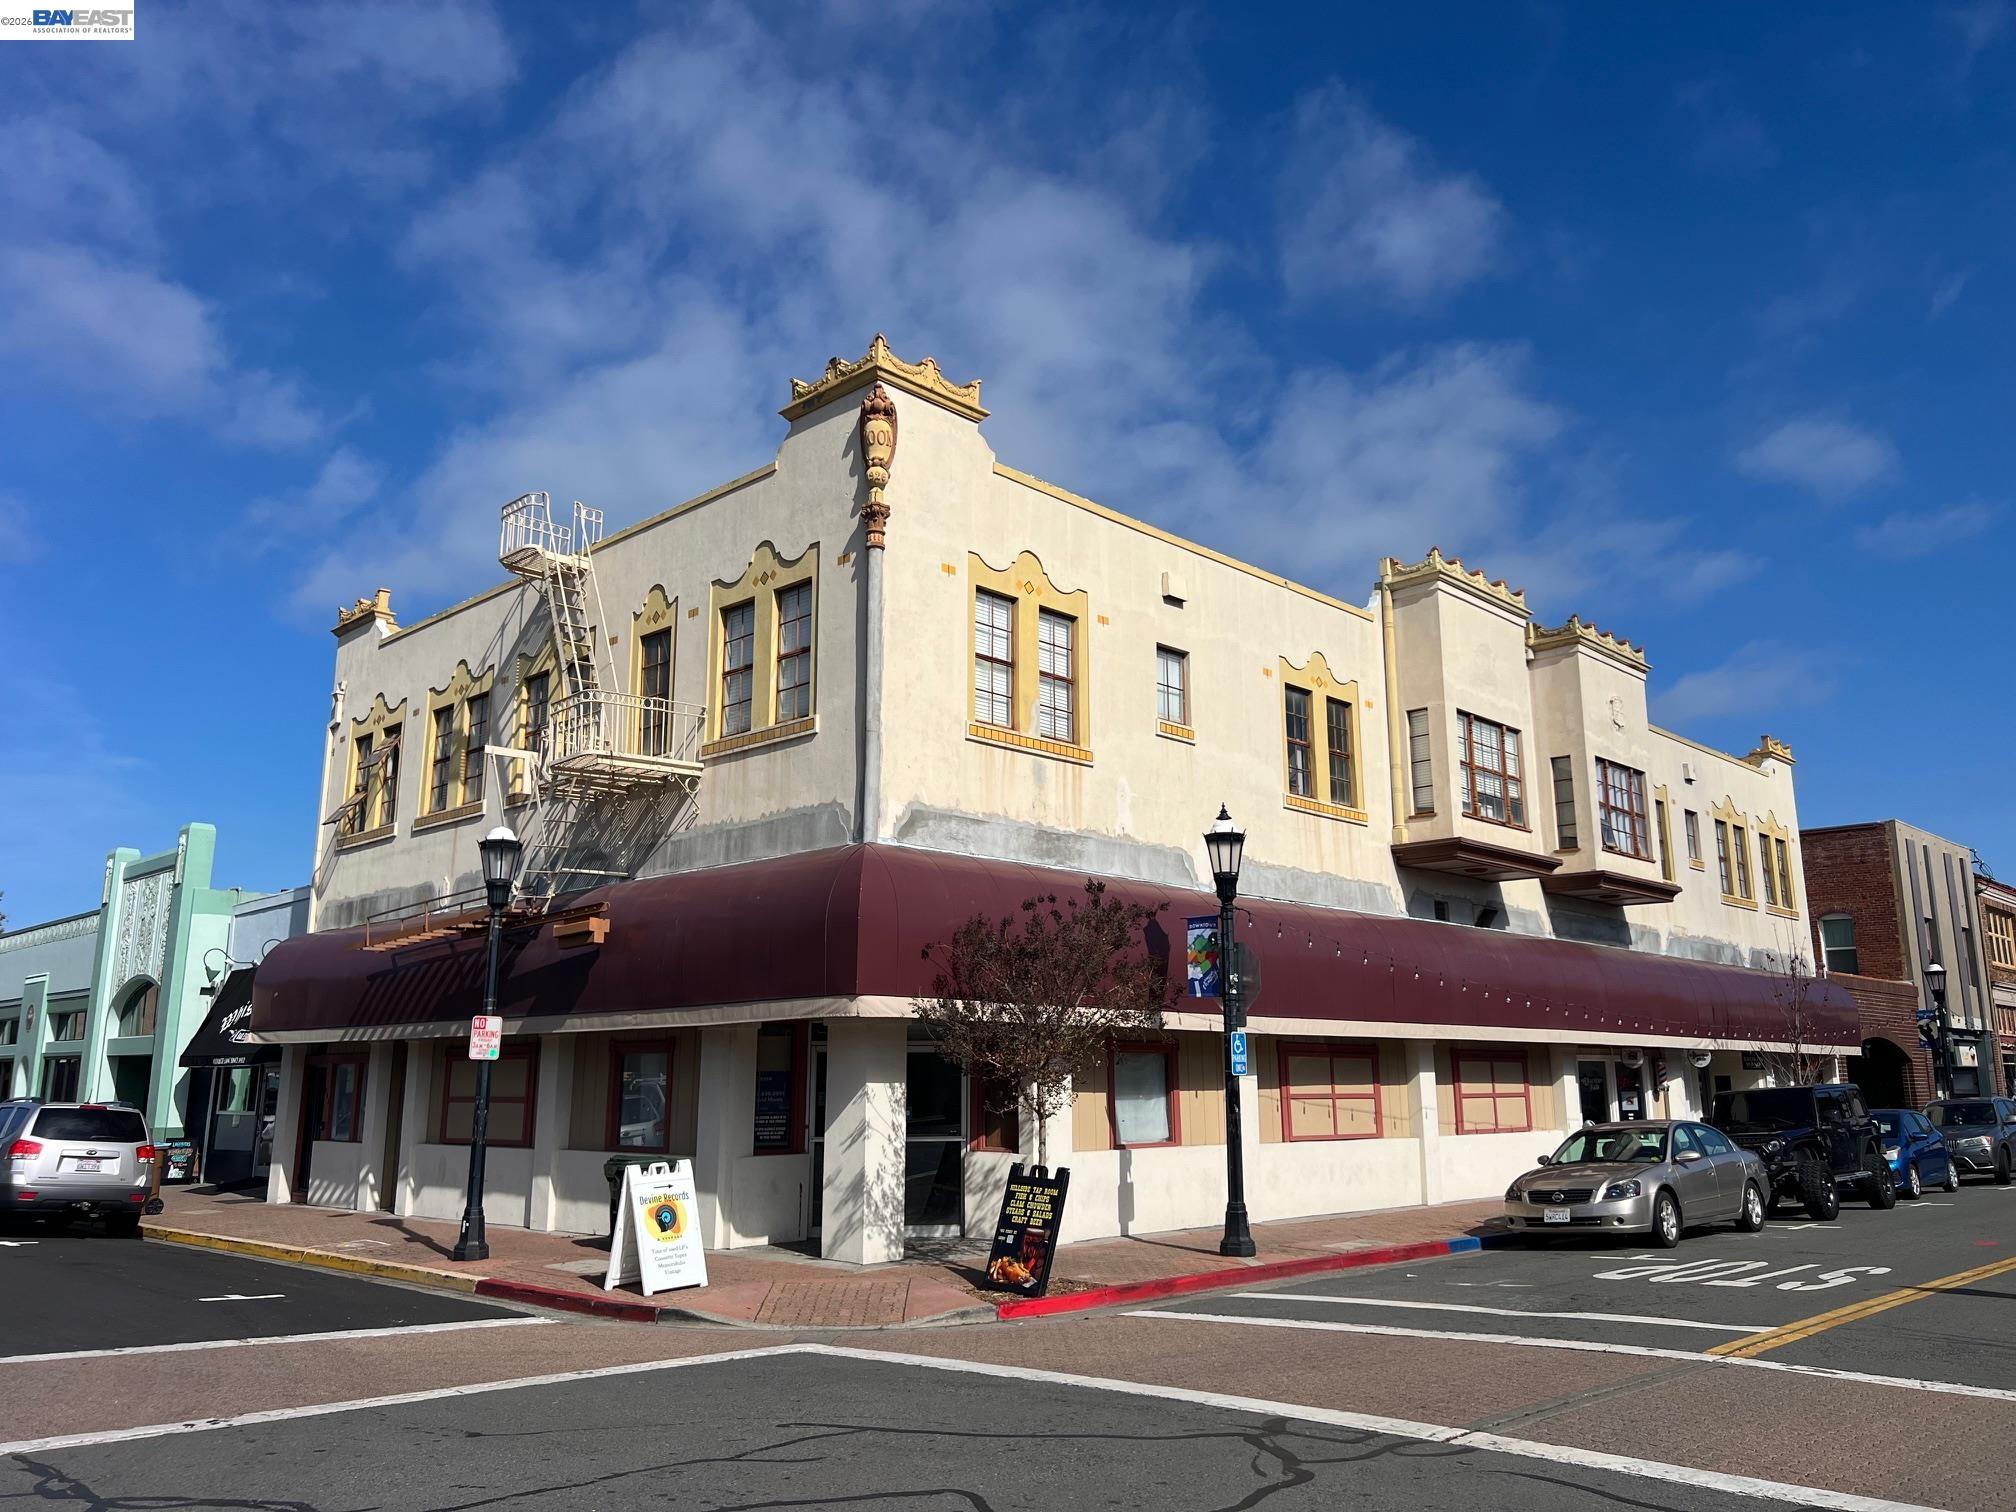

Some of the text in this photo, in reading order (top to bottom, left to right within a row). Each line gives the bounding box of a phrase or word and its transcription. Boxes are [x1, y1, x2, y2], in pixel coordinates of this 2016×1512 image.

[474, 1018, 486, 1029] NO
[473, 1030, 499, 1038] PARKING
[639, 1191, 690, 1205] Devine Records
[1010, 1199, 1051, 1211] CLAM CHOWDER
[1592, 1258, 1893, 1291] STOP
